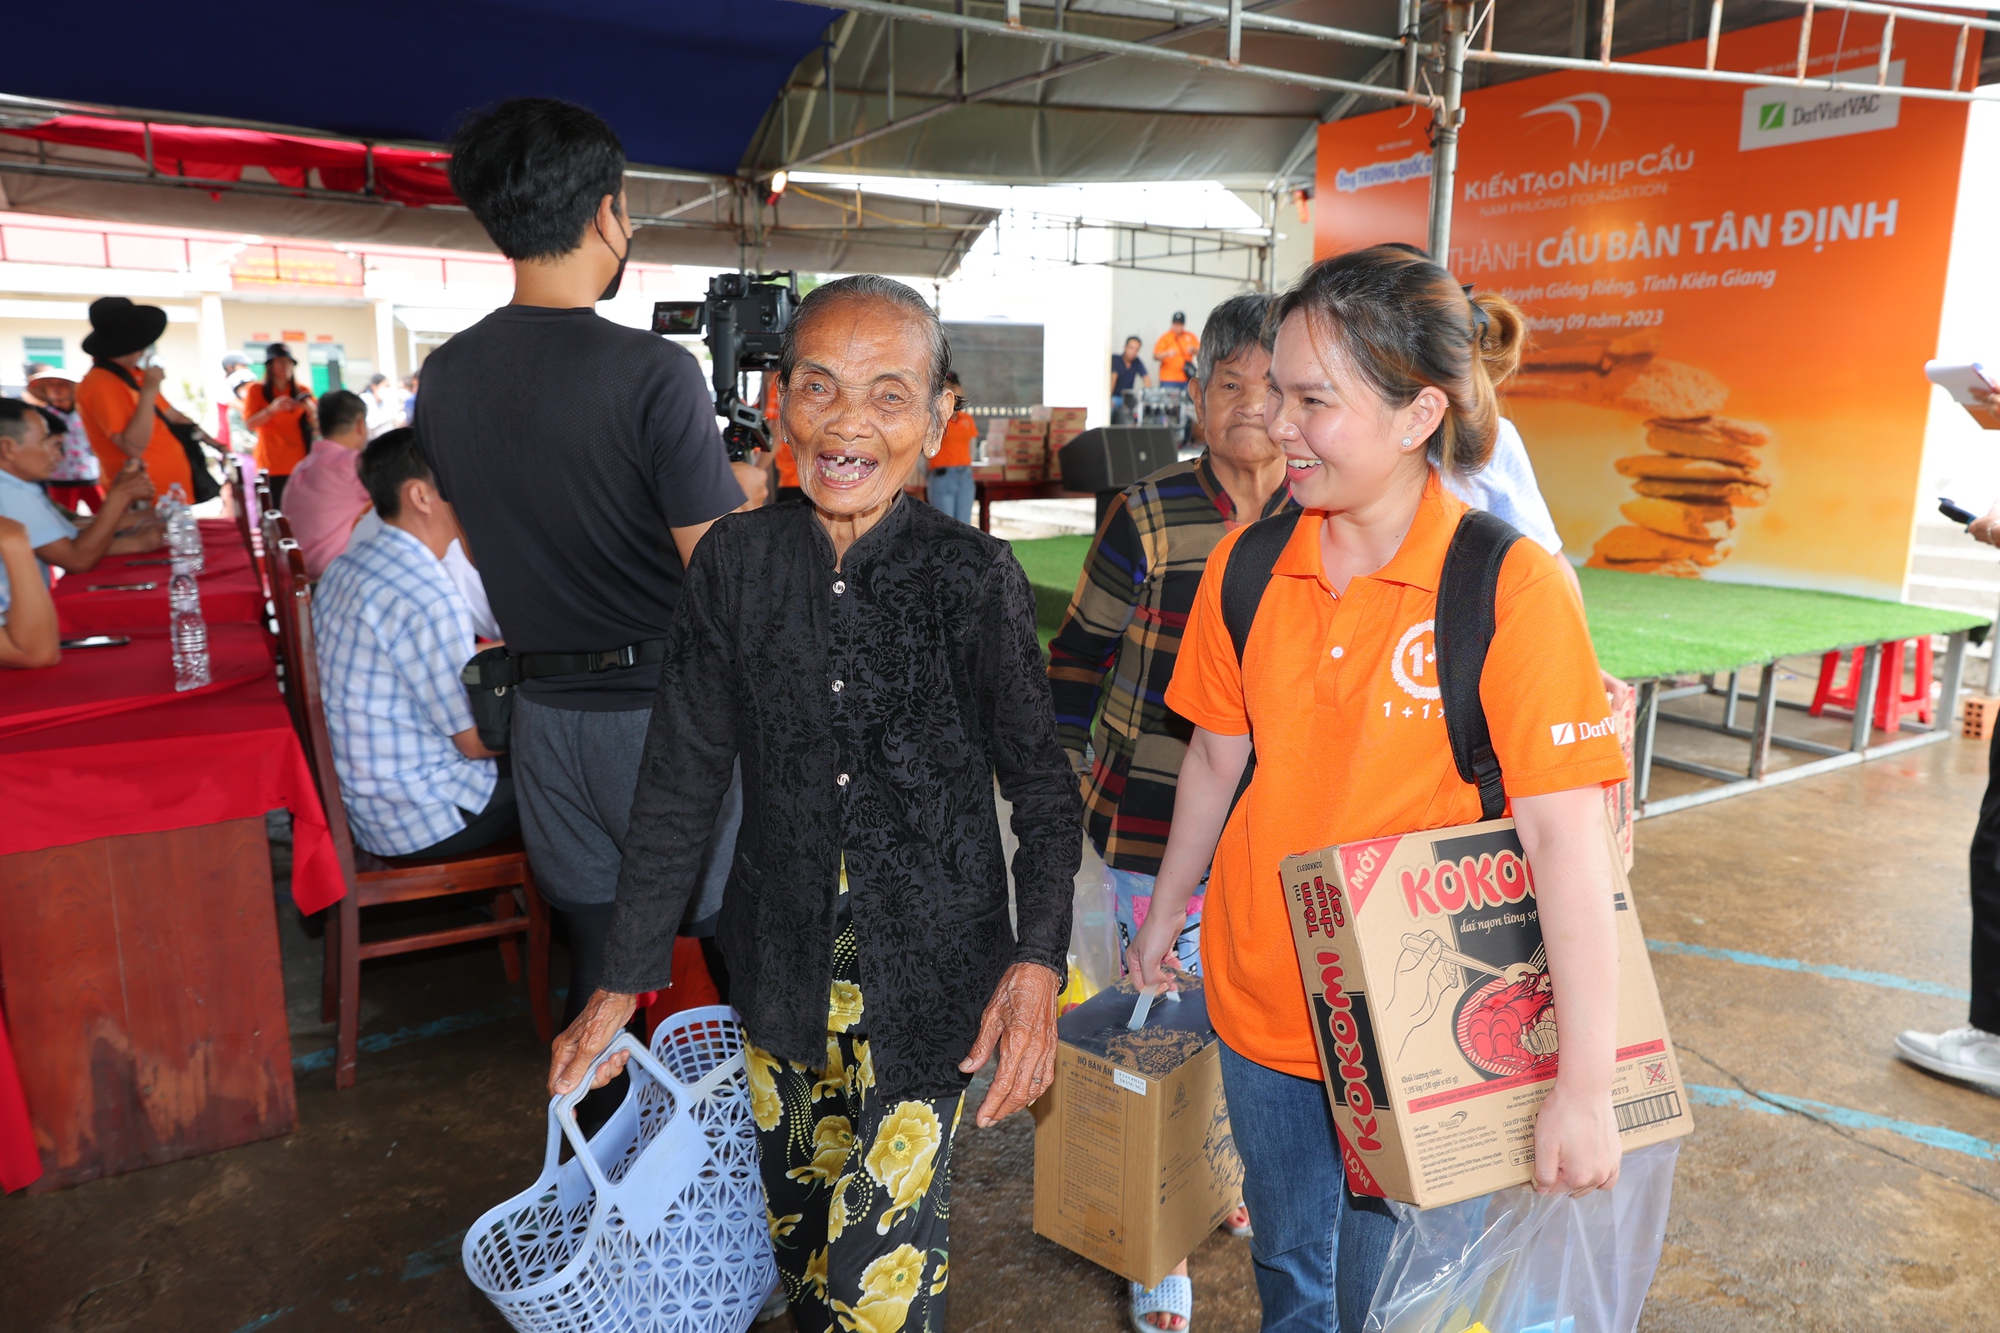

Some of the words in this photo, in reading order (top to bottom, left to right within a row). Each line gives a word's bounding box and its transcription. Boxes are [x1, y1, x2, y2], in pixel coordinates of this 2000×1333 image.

[1791, 93, 1881, 127] DatVietVAC
[1569, 182, 1669, 207] FOUNDATION
[1606, 221, 1681, 262] BÀN
[1689, 210, 1773, 255] TÂN
[1779, 198, 1899, 254] ĐỊNH
[1720, 267, 1777, 290] Giang
[1566, 312, 1587, 330] 09
[1623, 309, 1665, 328] 2023
[1350, 846, 1382, 890] MỚI
[1300, 881, 1320, 938] Tôm
[1313, 875, 1335, 939] chua
[1326, 882, 1345, 928] cay
[1477, 917, 1501, 935] ngon
[1528, 909, 1538, 921] sợ
[1315, 949, 1384, 1153] KOKOMI
[1438, 1118, 1459, 1129] Masan
[1344, 1149, 1371, 1189] MỚI
